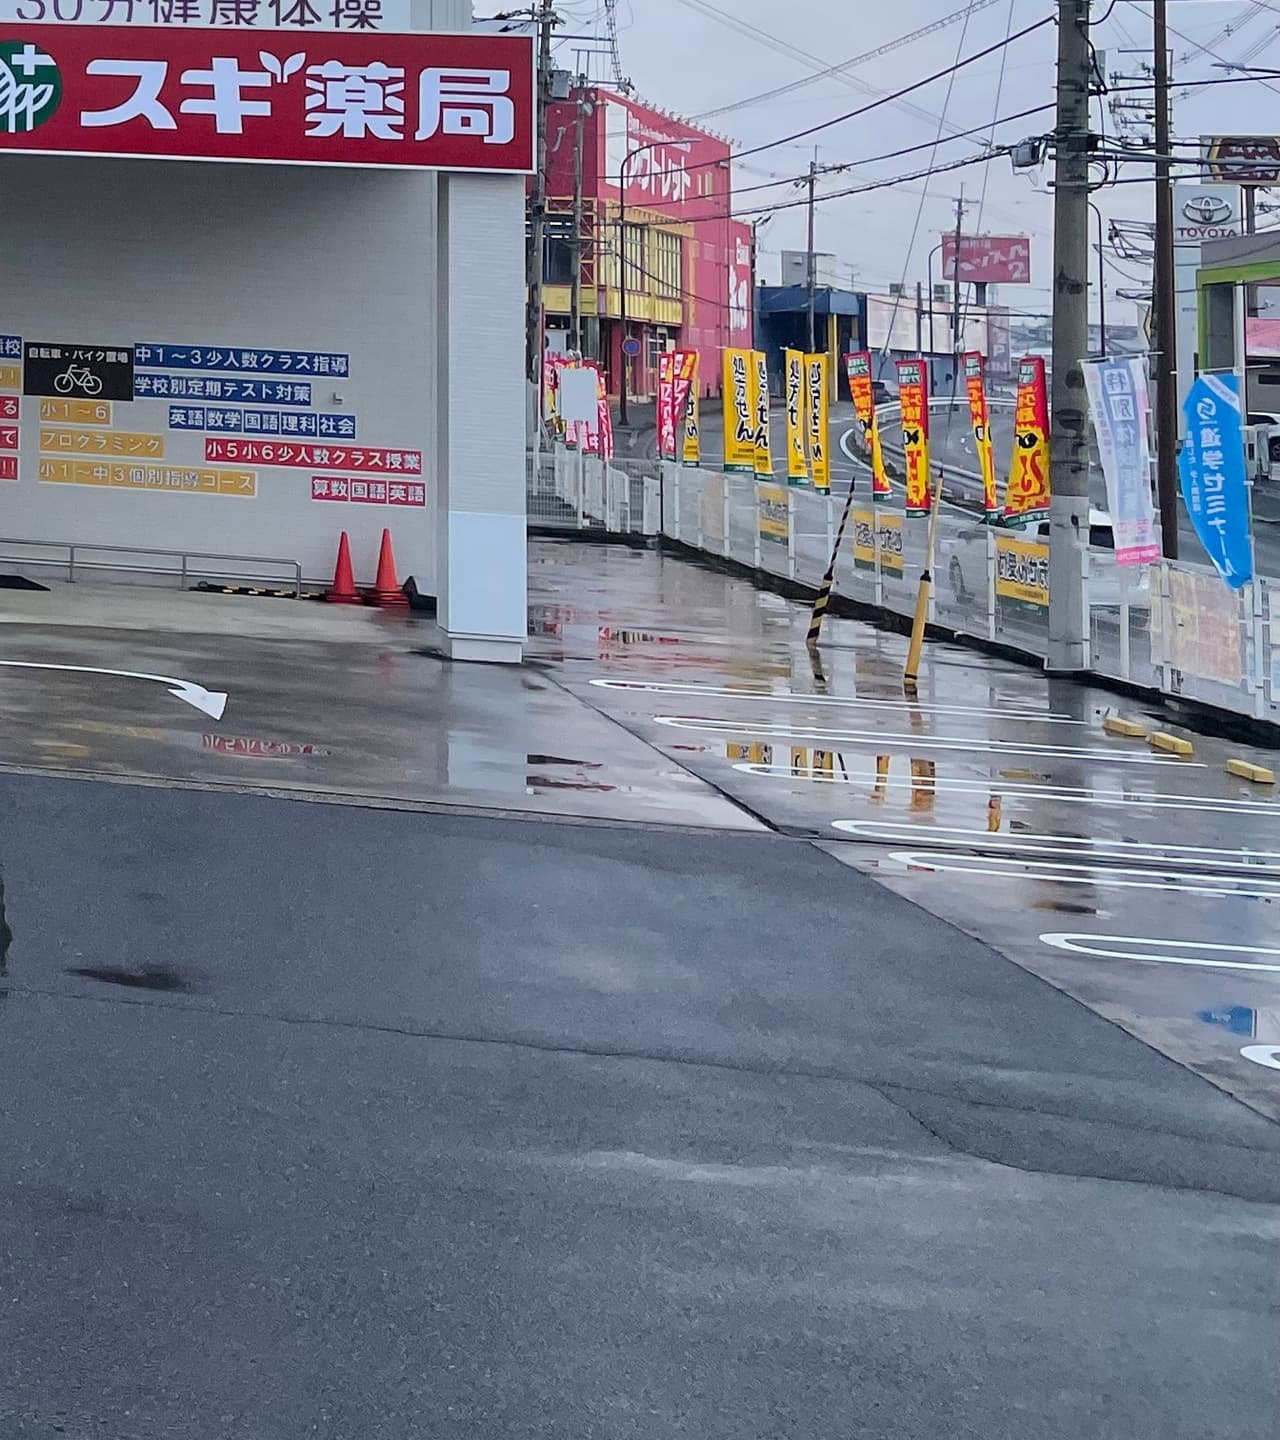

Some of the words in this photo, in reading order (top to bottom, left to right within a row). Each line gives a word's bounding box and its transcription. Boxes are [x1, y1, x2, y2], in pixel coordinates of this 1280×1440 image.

[80, 50, 515, 145] スギ薬局
[1177, 227, 1238, 239] TOYOTA
[135, 376, 311, 402] 学校別定期テスト対策
